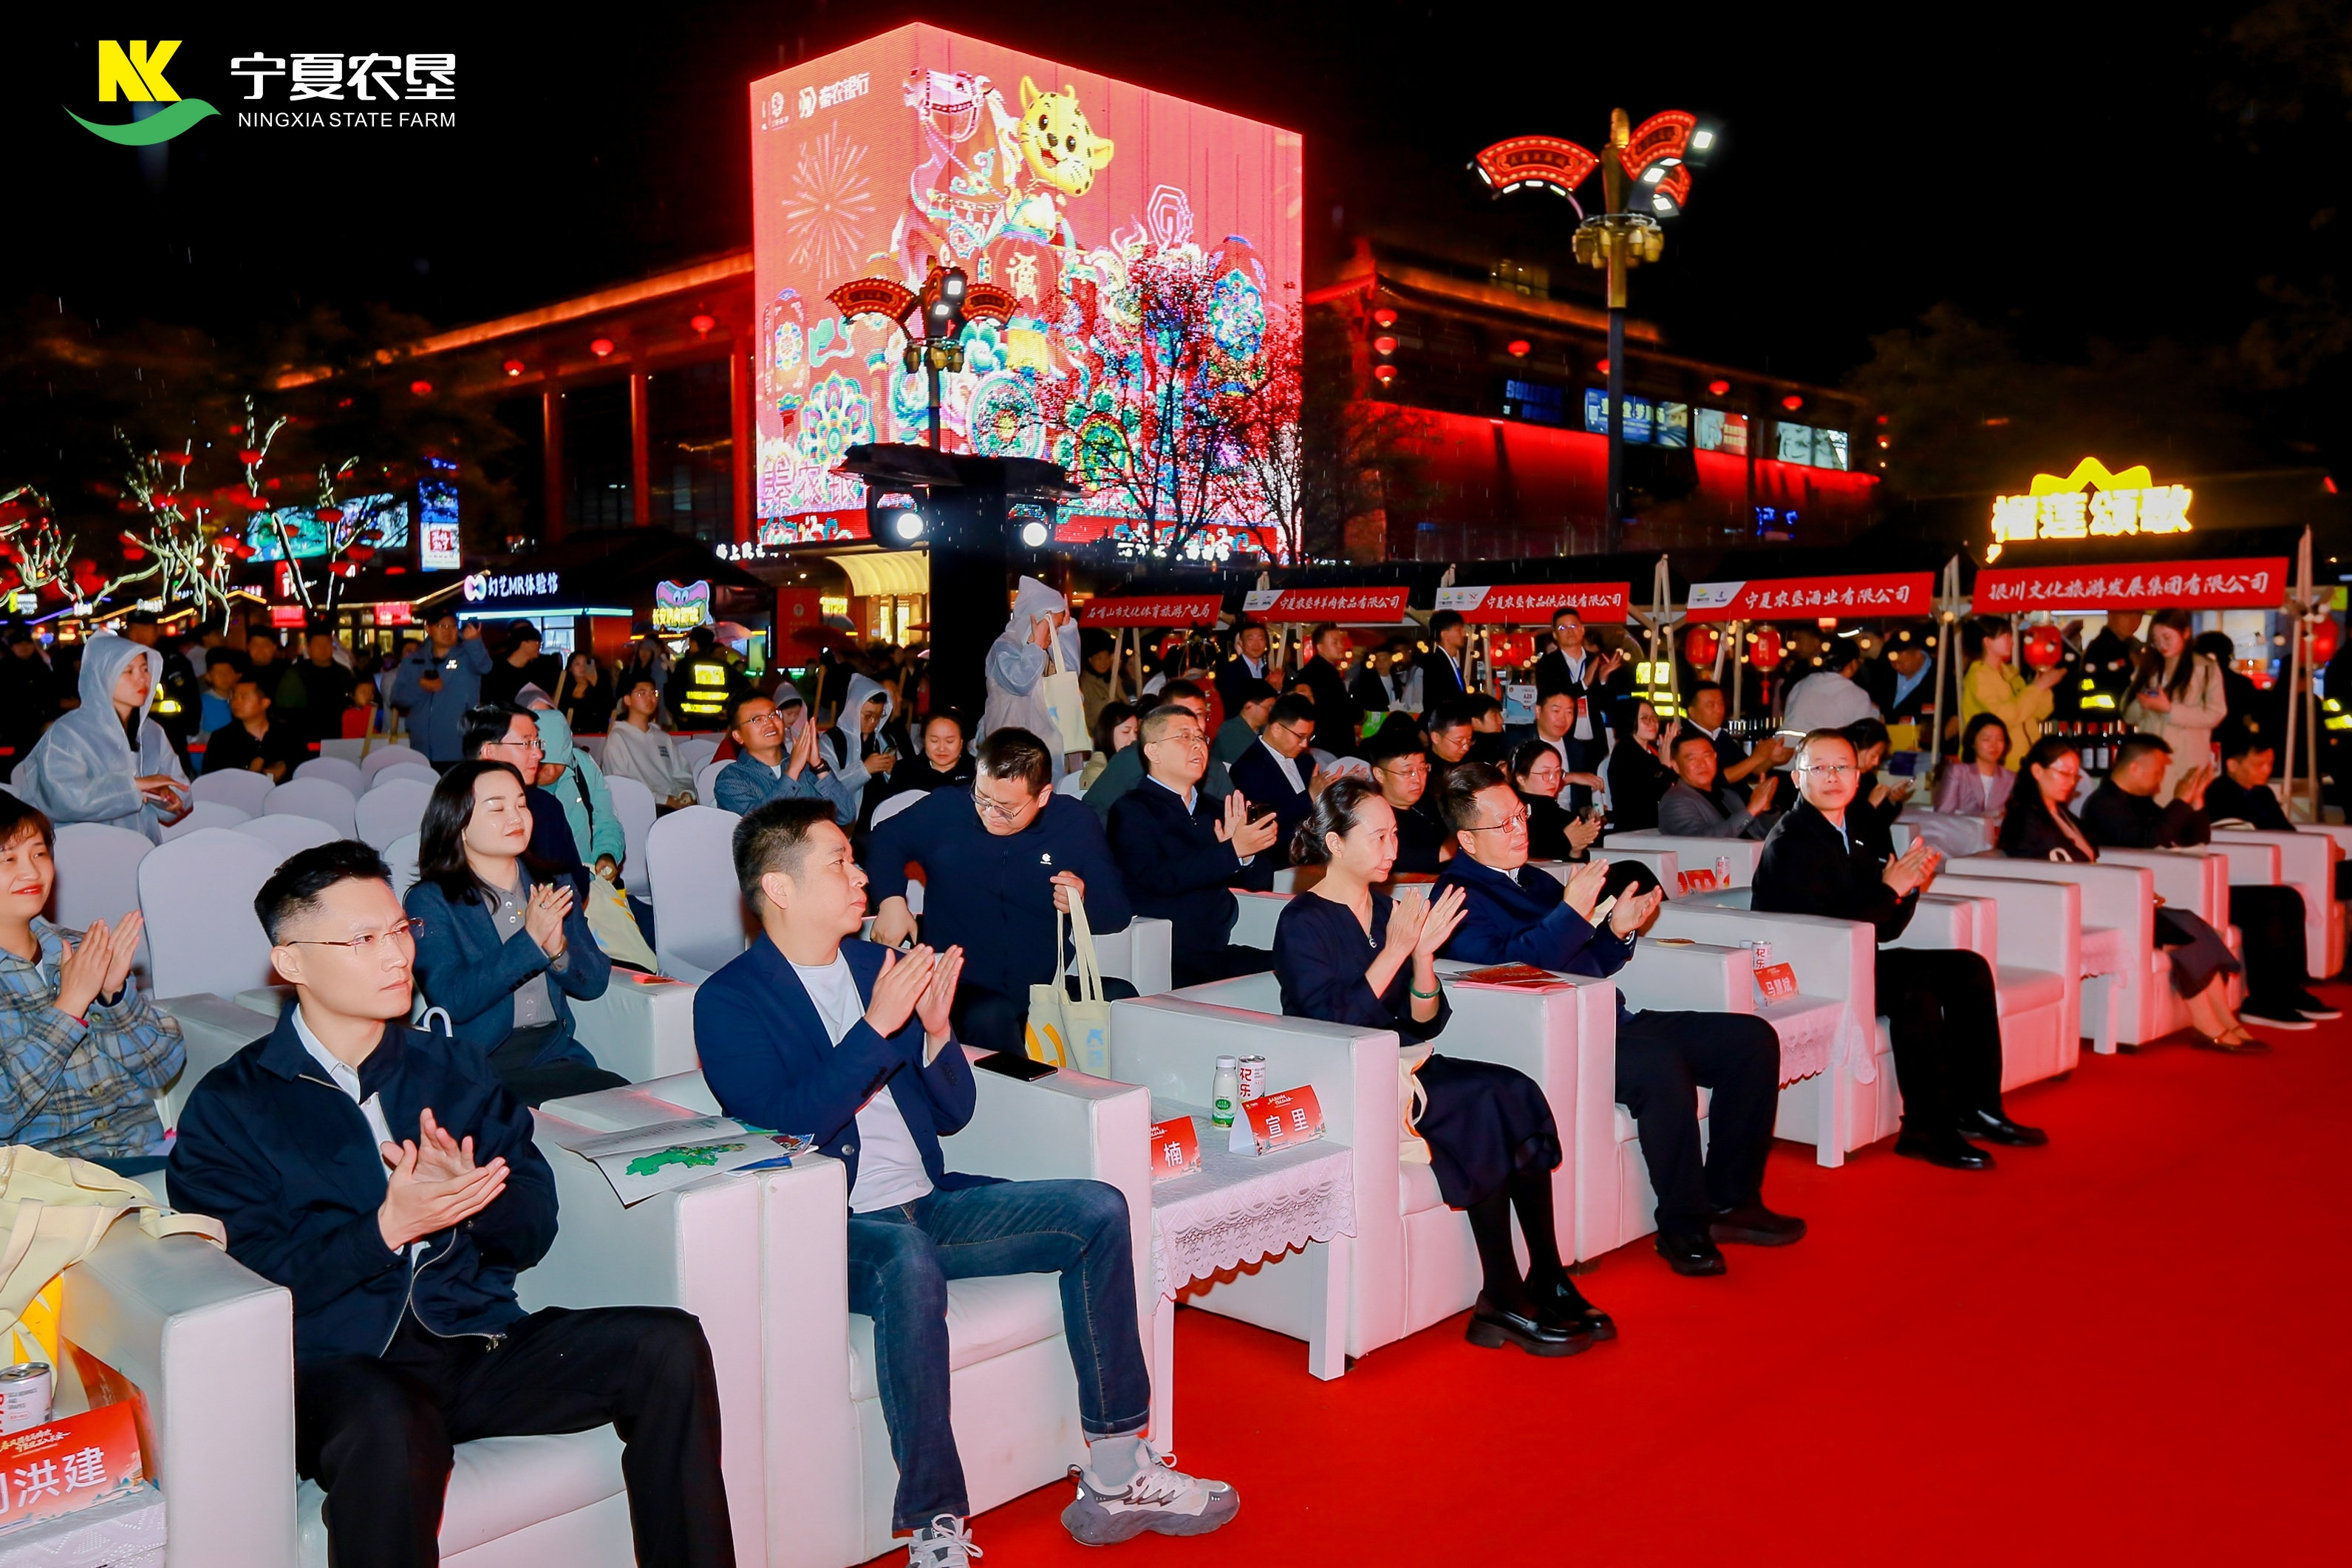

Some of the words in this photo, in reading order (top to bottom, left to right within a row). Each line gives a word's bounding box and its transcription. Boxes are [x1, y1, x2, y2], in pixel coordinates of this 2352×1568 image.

[1745, 584, 1910, 610] 宁夏农垦酒业有限公司
[1988, 571, 2269, 601] 银川文化旅游发展集团有限公司
[1279, 595, 1400, 610] 宁夏农垦牛羊肉食品有限公司
[1487, 593, 1621, 610] 宁夏农垦食品供应链有限公司
[1265, 1108, 1309, 1139] 宣里
